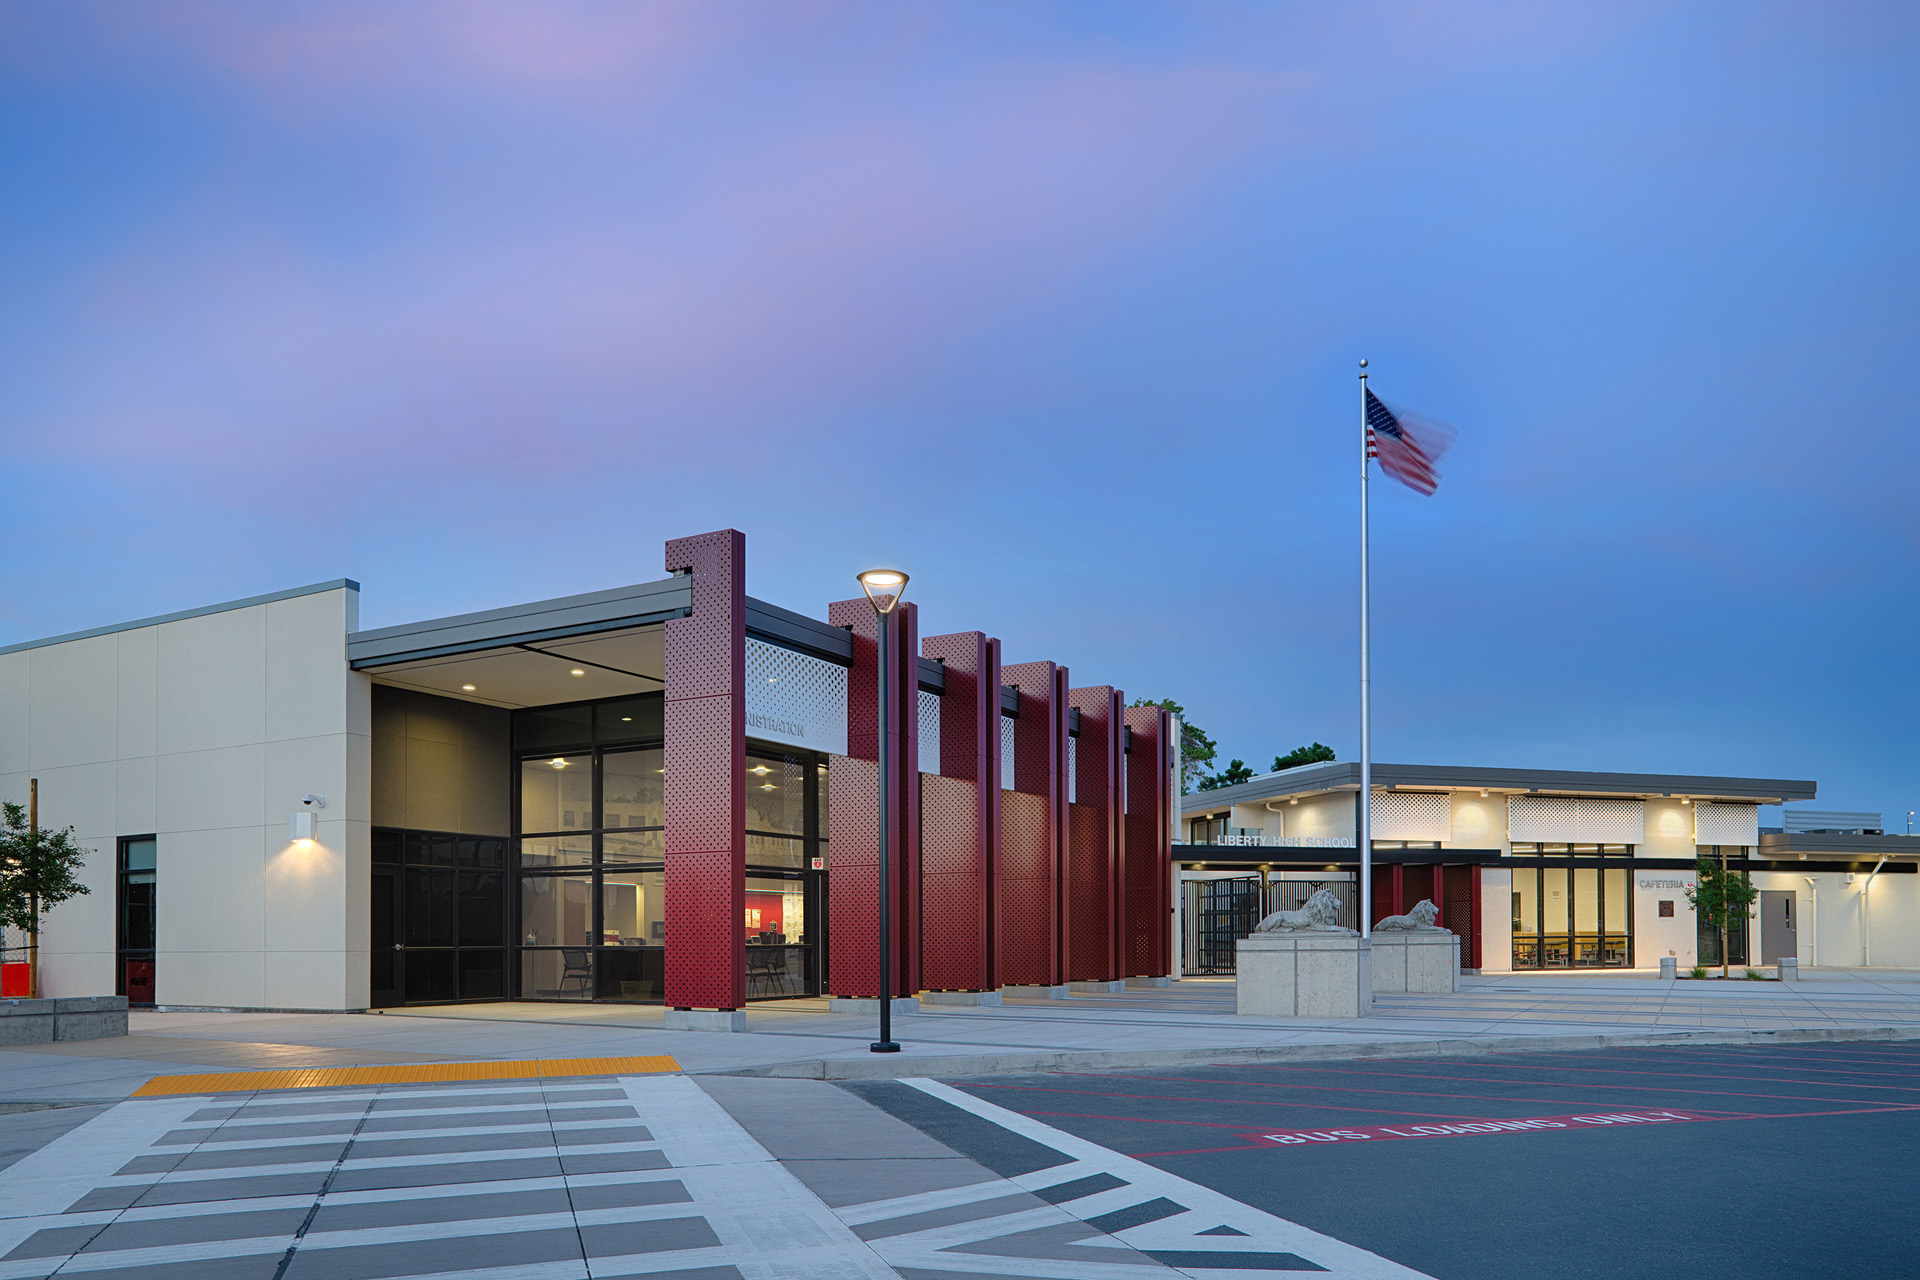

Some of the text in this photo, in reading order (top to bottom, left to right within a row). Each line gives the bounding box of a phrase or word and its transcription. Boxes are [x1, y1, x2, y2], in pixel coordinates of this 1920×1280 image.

[1217, 835, 1356, 848] LIBERTY HIGH SCHOOL
[1639, 880, 1684, 889] CAFETERIA
[1262, 1112, 1692, 1144] BUS LOADING ONLY
